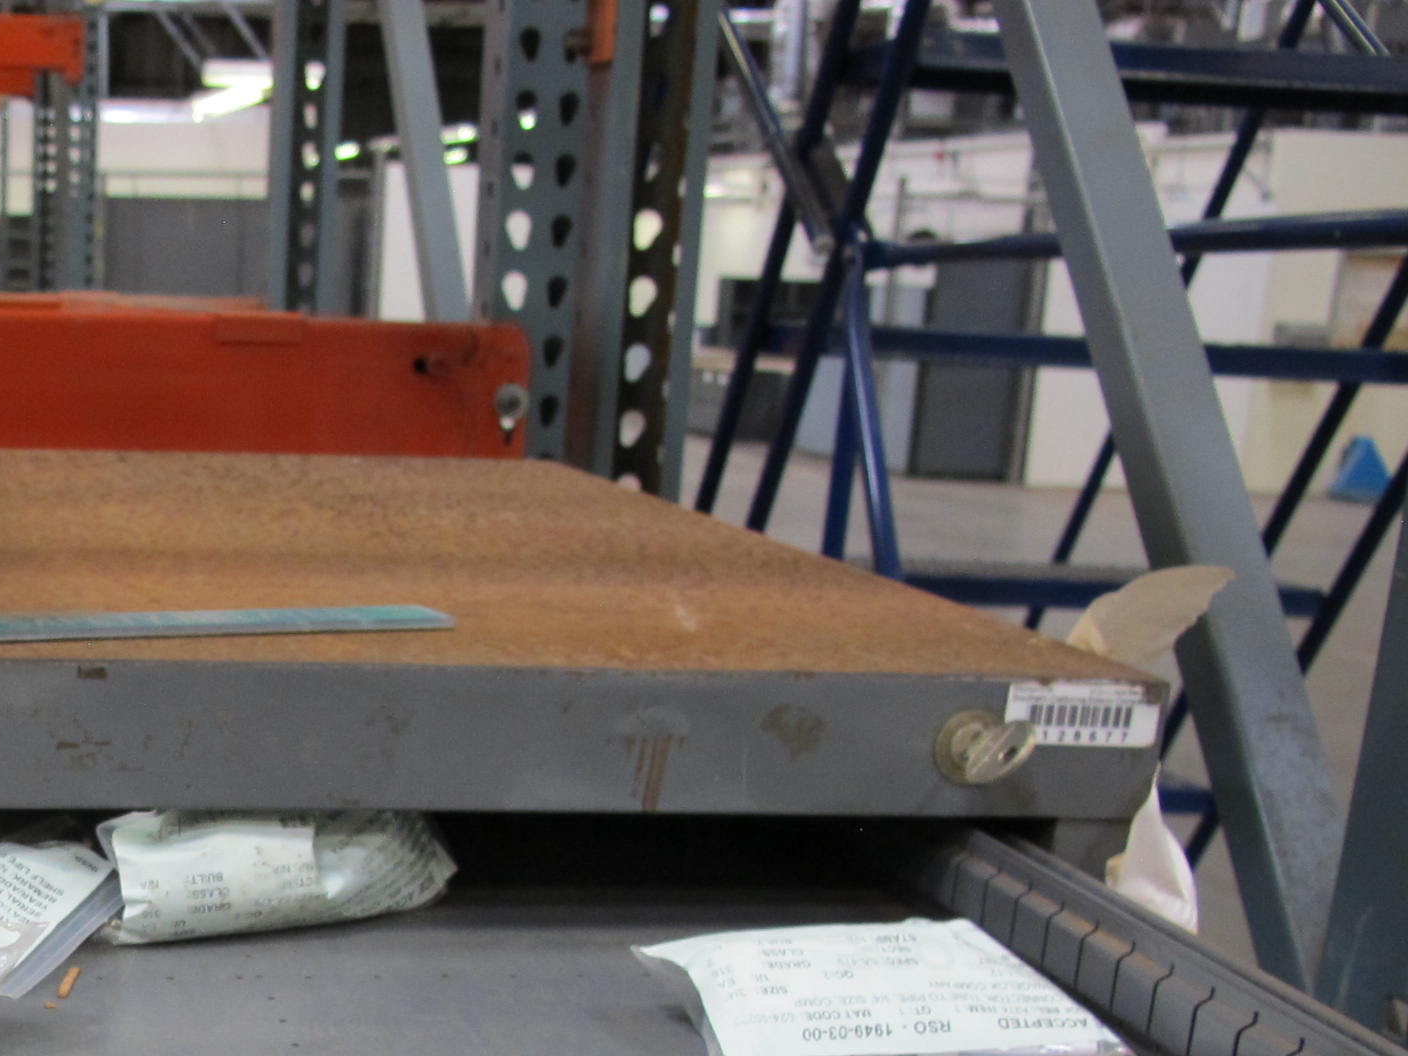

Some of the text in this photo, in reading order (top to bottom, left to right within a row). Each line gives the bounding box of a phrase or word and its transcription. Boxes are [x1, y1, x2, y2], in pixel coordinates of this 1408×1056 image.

[912, 1019, 951, 1034] RSO
[996, 1017, 1088, 1030] ACCEPTED
[802, 1023, 893, 1040] 1949-03-00
